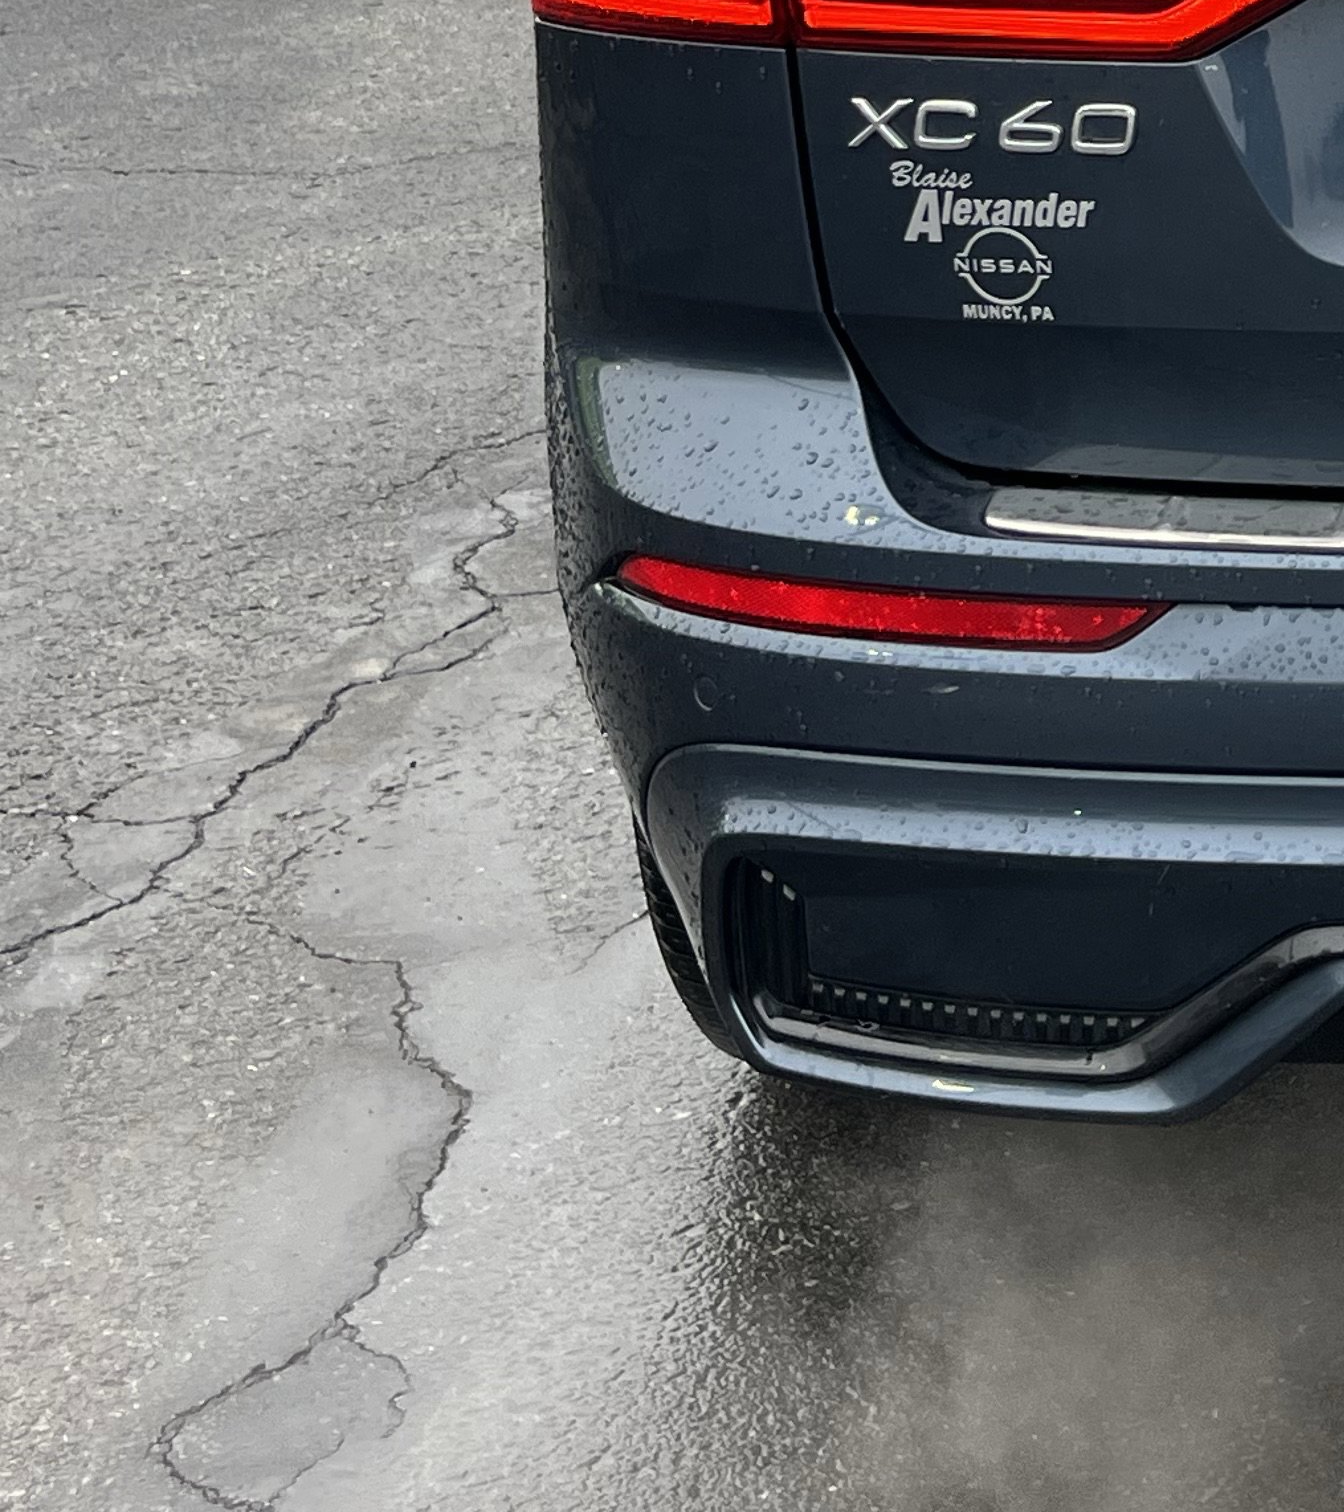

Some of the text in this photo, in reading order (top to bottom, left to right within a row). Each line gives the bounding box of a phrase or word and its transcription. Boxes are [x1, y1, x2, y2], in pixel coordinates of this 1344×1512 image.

[889, 160, 974, 189] Blaise
[903, 189, 1096, 243] Alexander
[954, 257, 1052, 274] NISSAN
[962, 304, 1055, 323] MUNCY, PA
